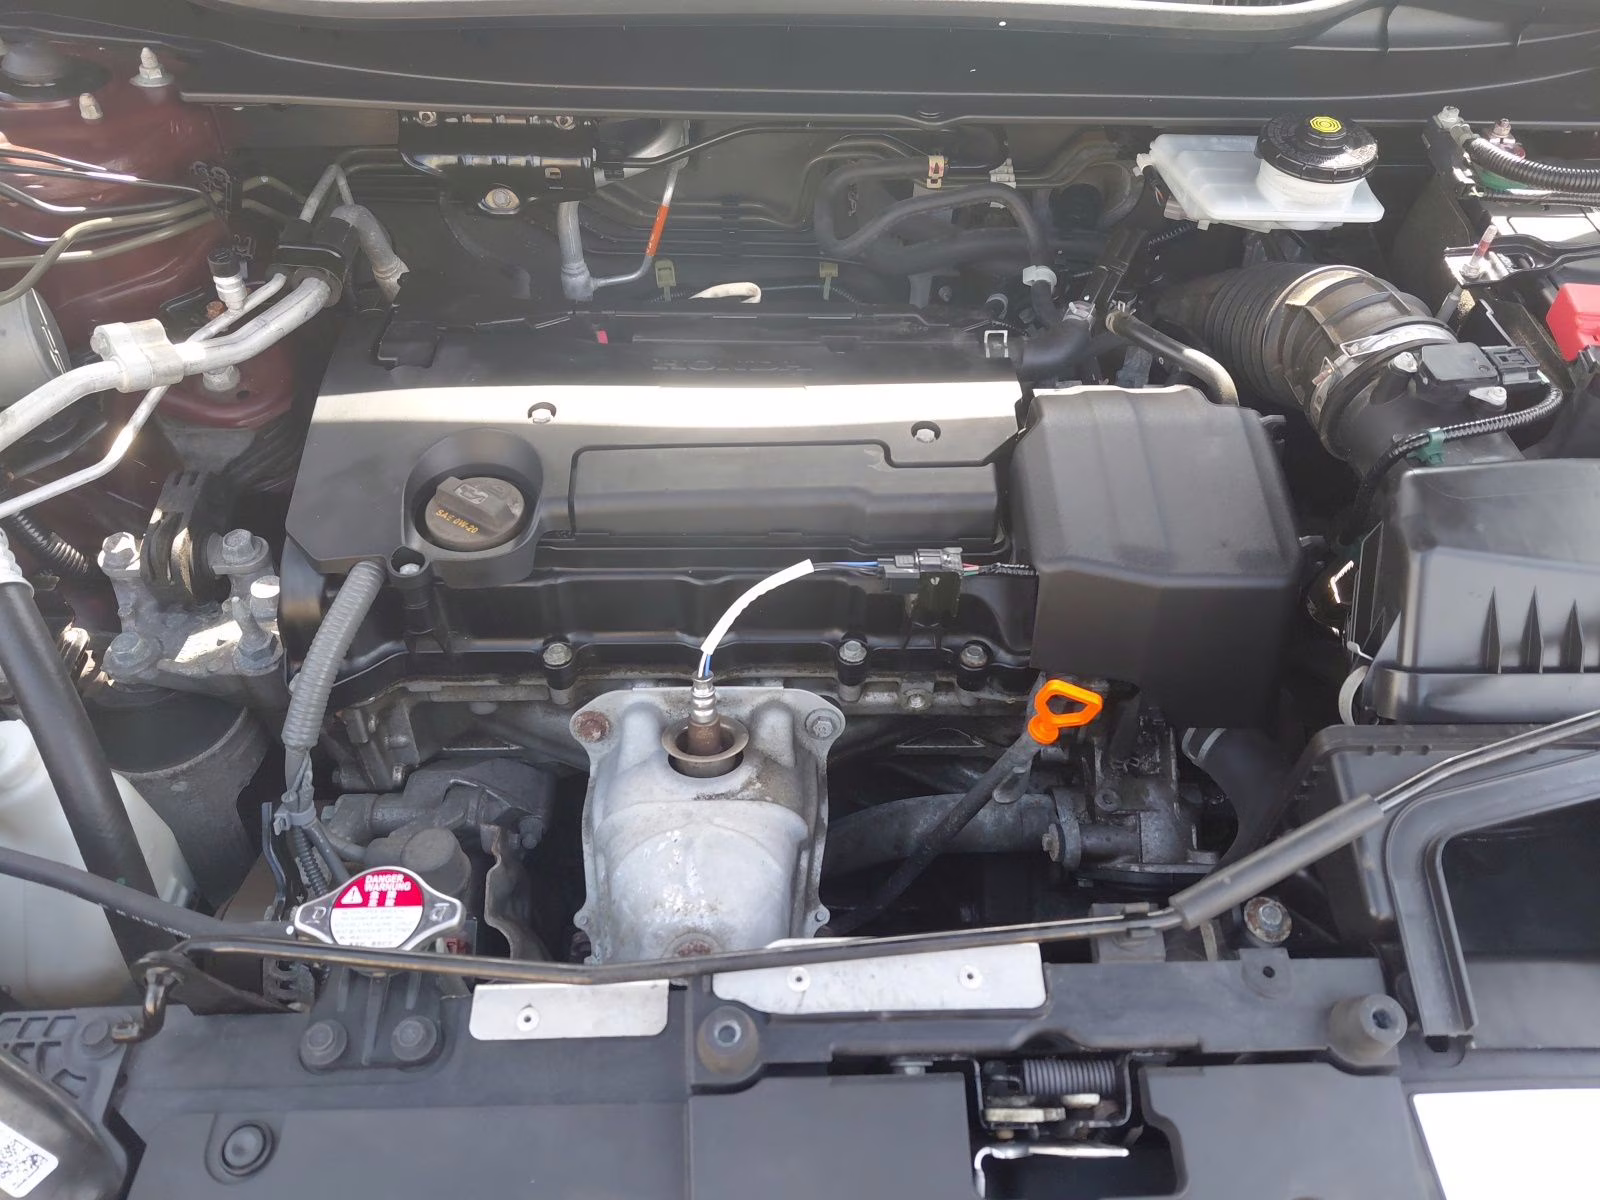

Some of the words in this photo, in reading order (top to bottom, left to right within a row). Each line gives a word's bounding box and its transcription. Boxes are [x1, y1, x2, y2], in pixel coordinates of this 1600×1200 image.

[435, 509, 454, 522] SAE
[453, 518, 479, 534] 0W-20
[365, 874, 404, 883] DANGER
